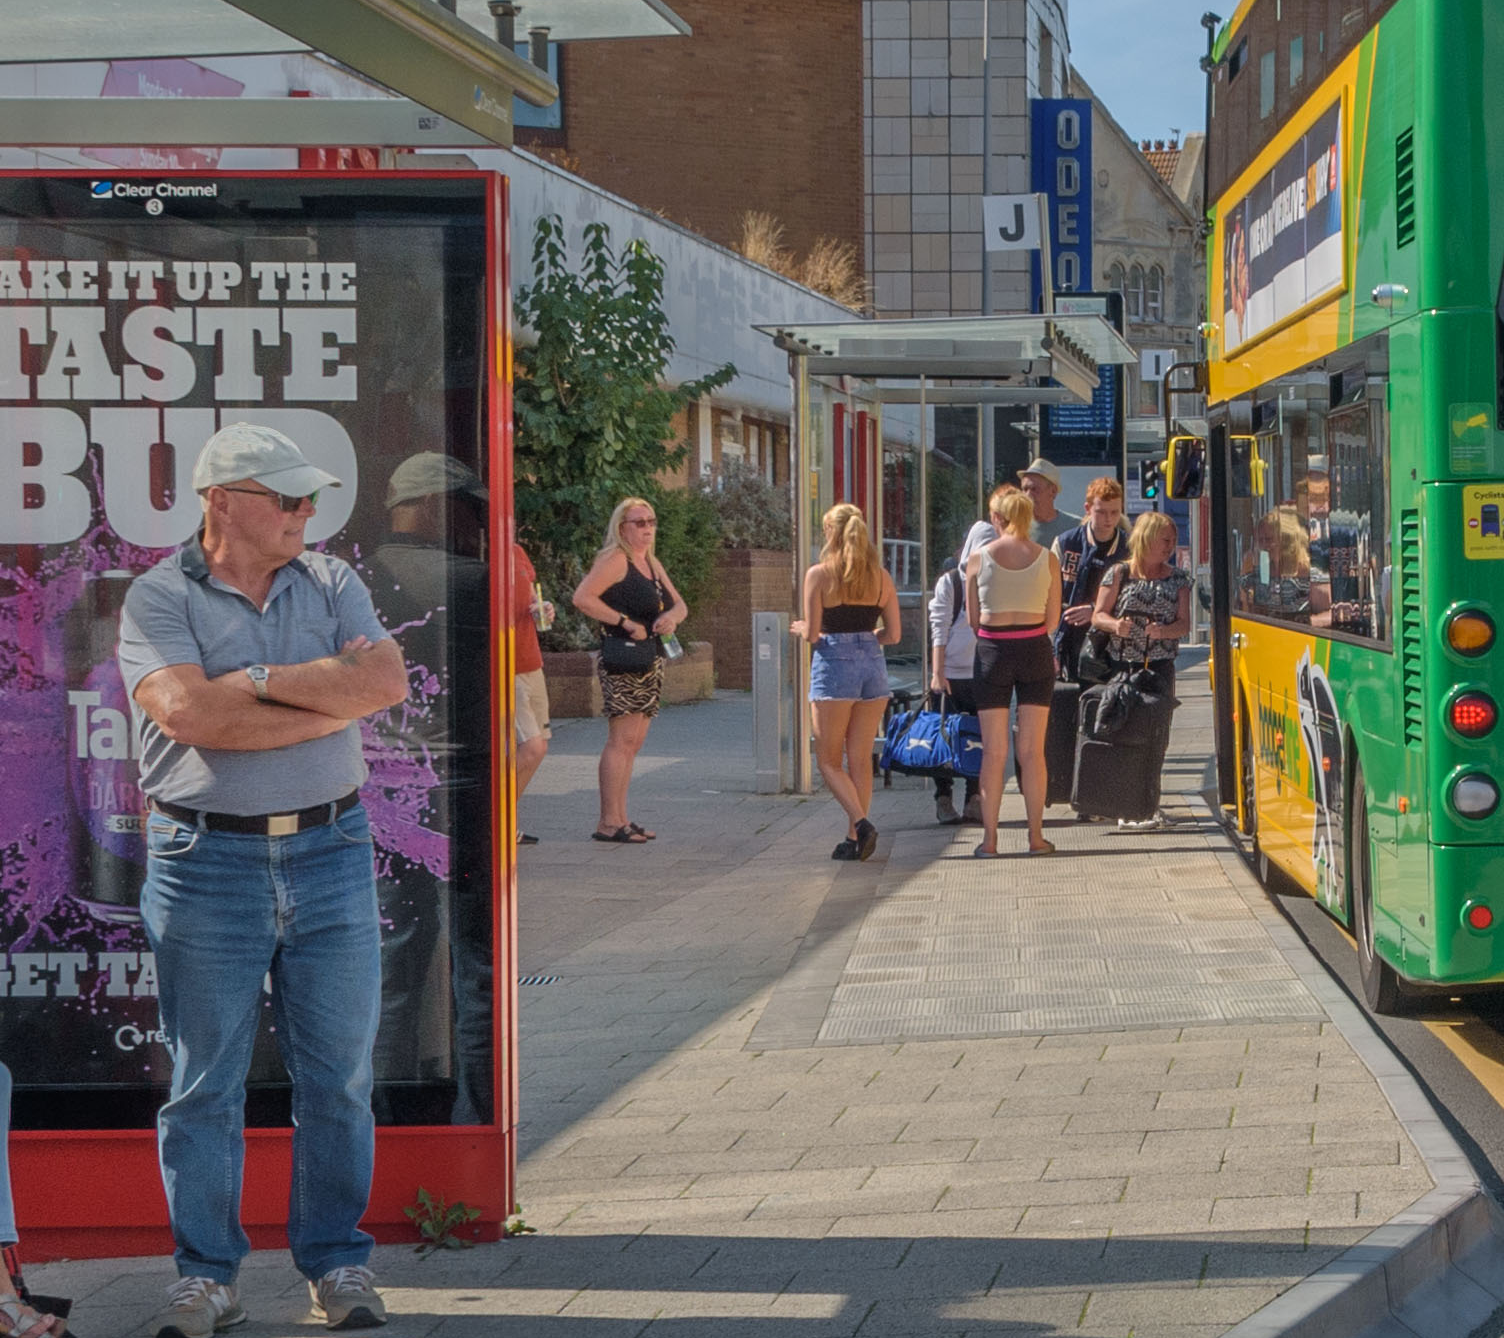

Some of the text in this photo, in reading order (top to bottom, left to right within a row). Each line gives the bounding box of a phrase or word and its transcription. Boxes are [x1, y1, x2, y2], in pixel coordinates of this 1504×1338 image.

[114, 182, 217, 197] Clear Channel
[148, 199, 161, 215] 3
[1057, 110, 1080, 291] ODEO
[999, 204, 1024, 242] J
[108, 261, 163, 300] IT
[172, 261, 243, 301] UP
[251, 262, 357, 301] THE
